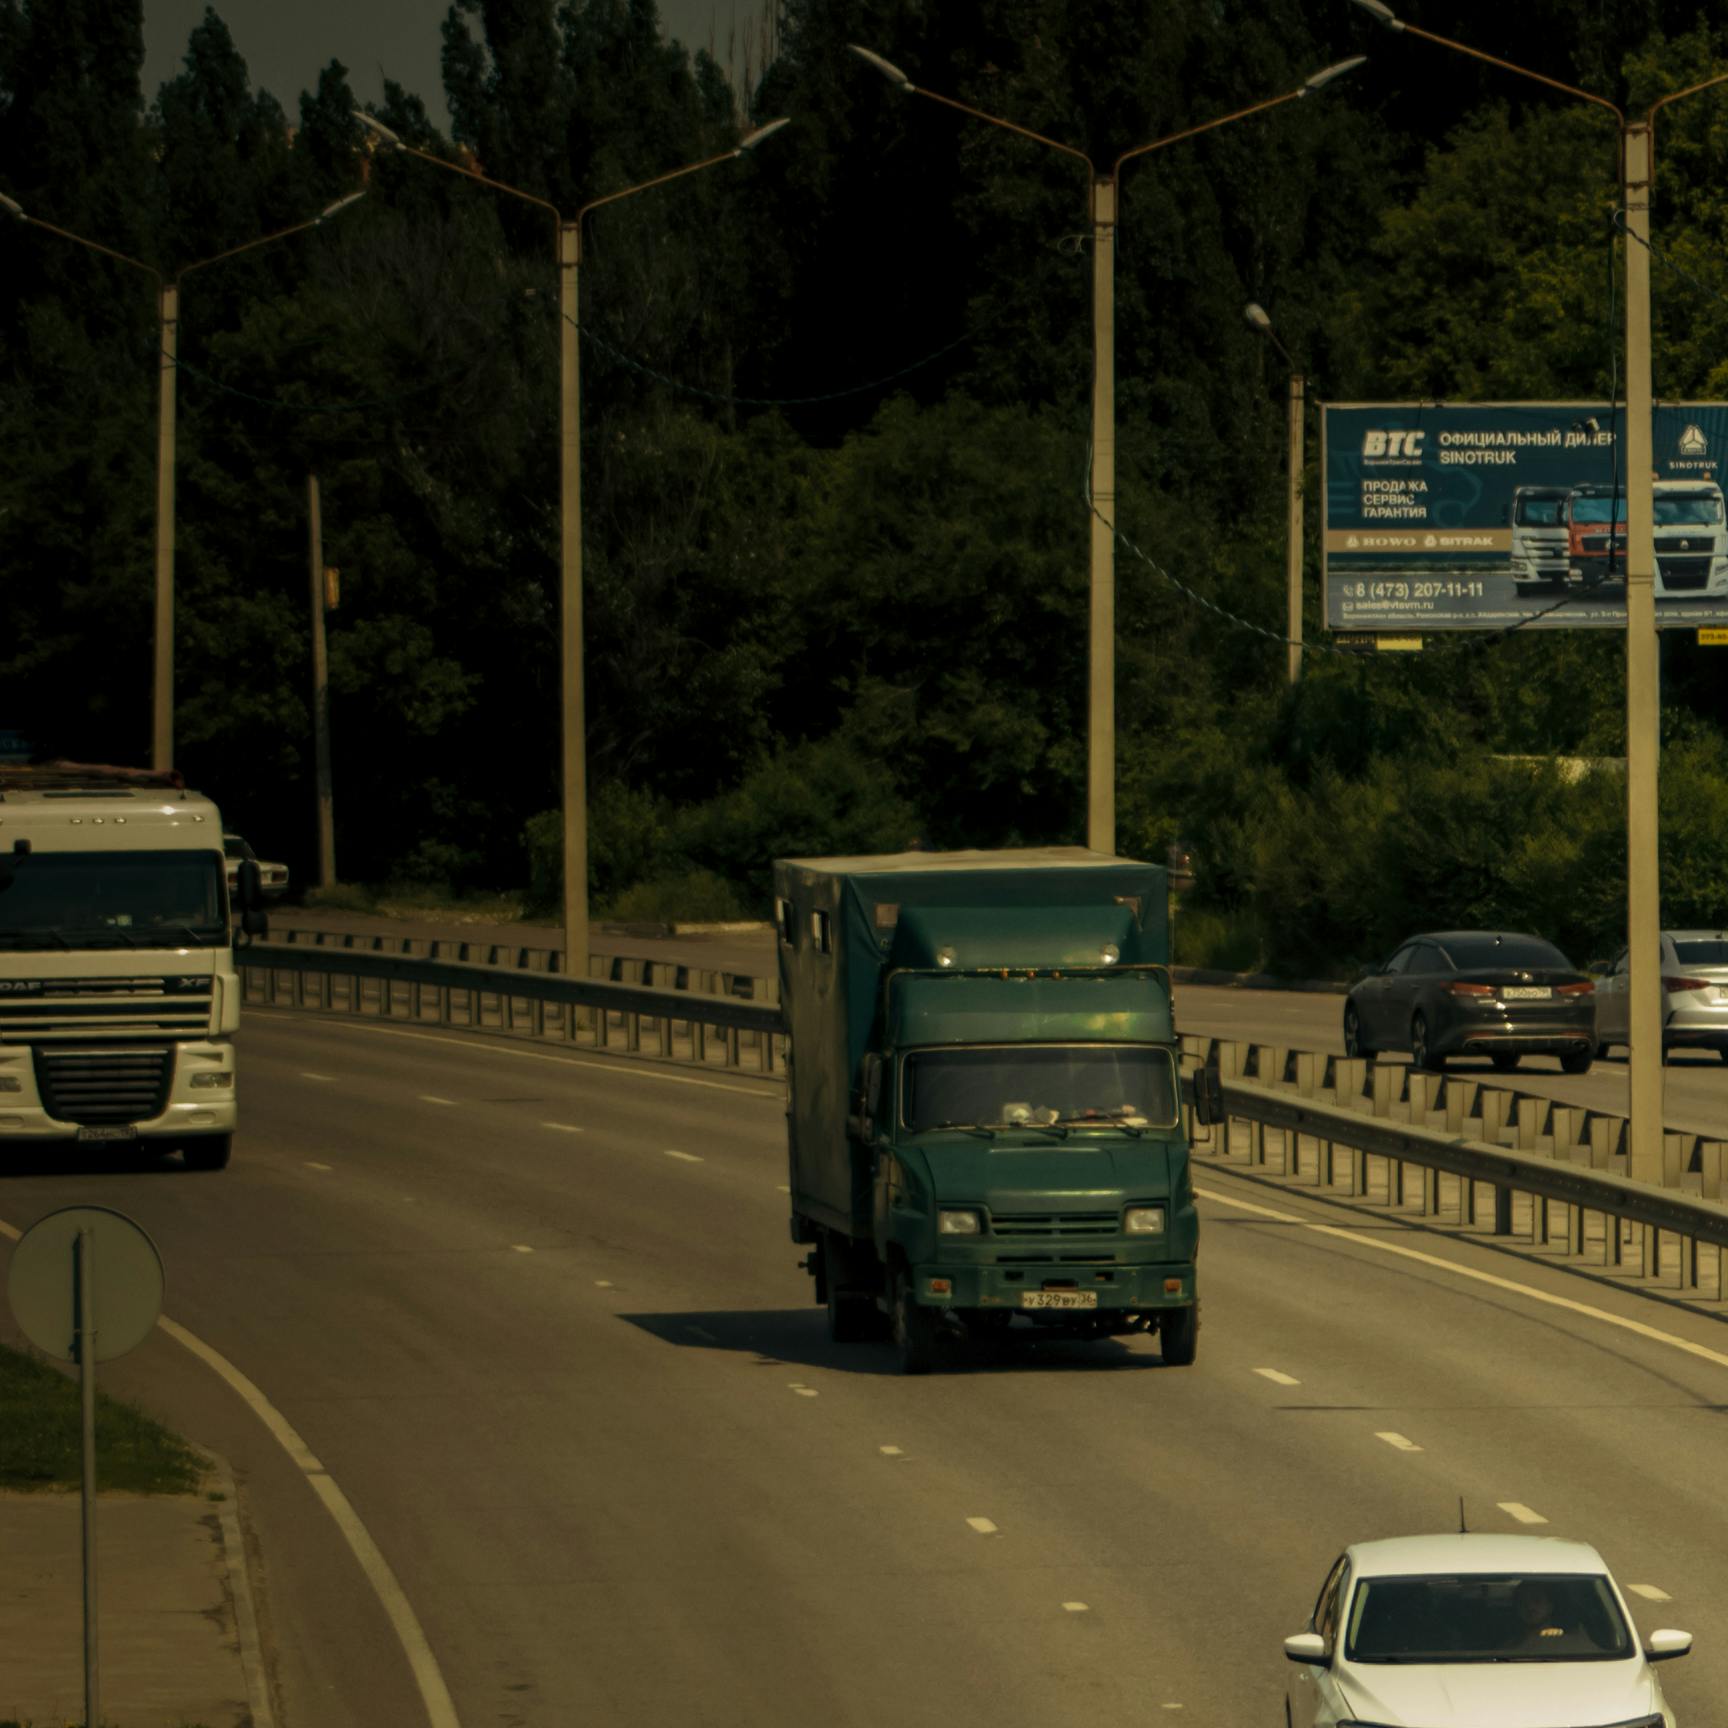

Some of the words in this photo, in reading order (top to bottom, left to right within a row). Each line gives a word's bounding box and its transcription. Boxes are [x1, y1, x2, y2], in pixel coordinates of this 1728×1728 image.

[1440, 430, 1561, 448] ОФИЦИАЛЬНЫЙ
[1440, 450, 1517, 465] SINOTRUK
[1669, 461, 1718, 470] SINOTRUK
[1363, 480, 1428, 493] ПРОДАЖА
[1363, 494, 1415, 505] СЕРВИС
[1363, 507, 1427, 518] ГАРАНТИЯ
[1363, 537, 1416, 546] HOWO
[1439, 537, 1493, 546] SITRAK
[1356, 582, 1366, 597] 8
[1370, 582, 1409, 600] (473)
[1414, 582, 1484, 597] 207-11-11
